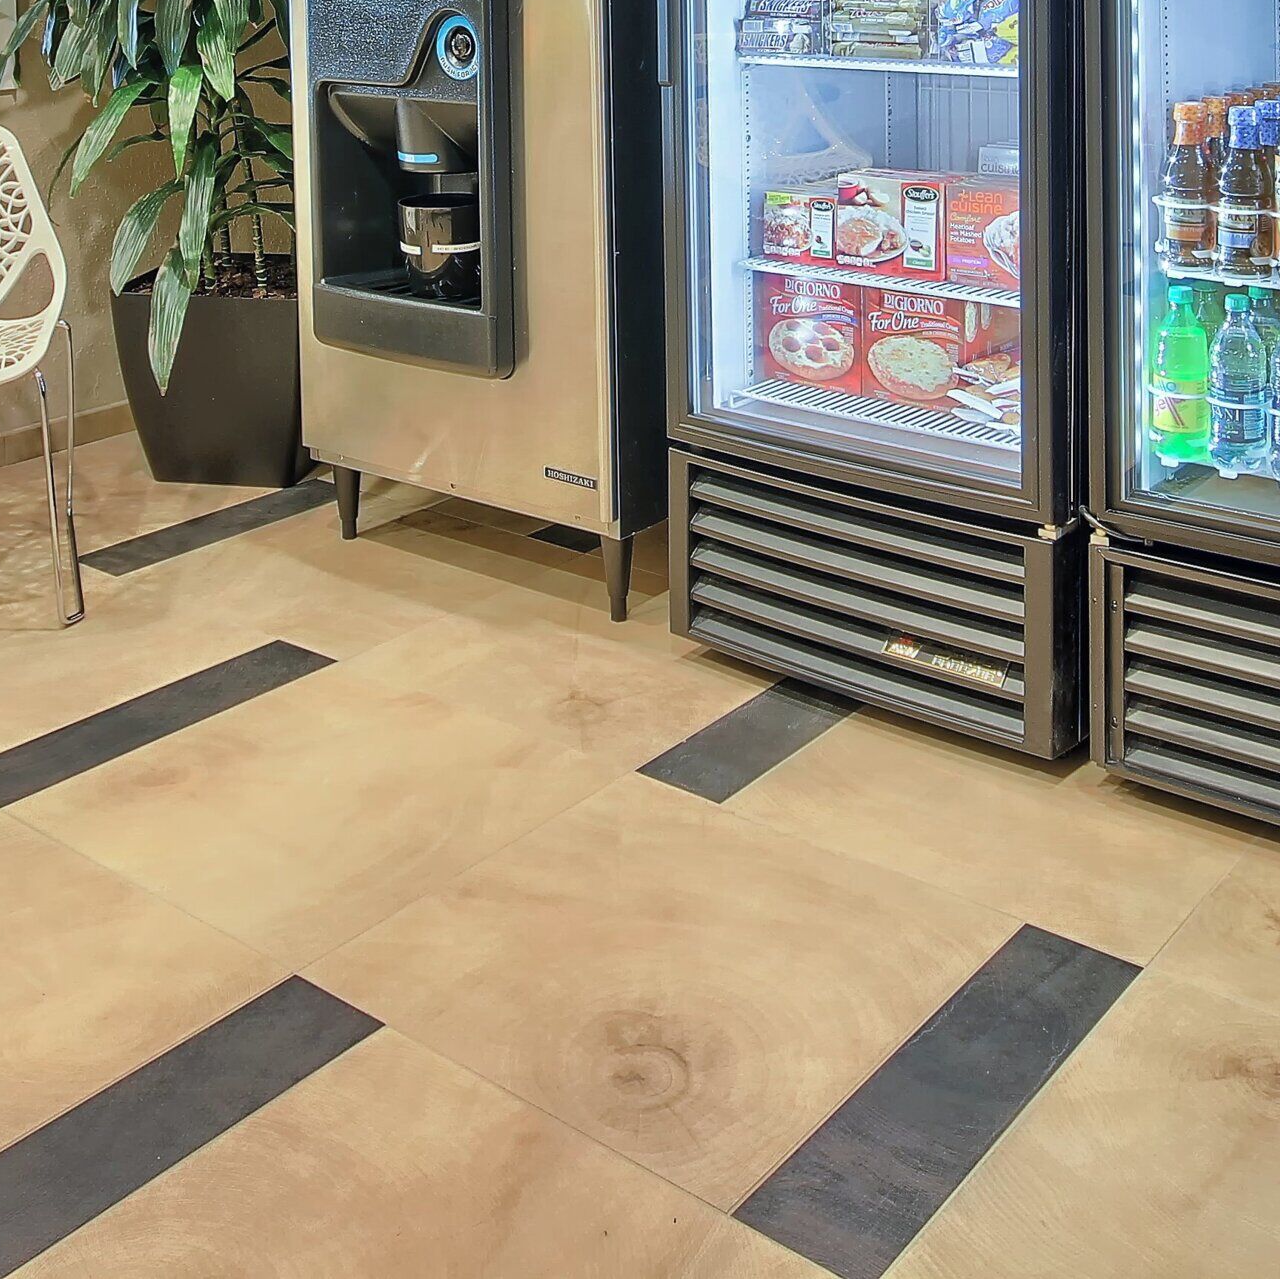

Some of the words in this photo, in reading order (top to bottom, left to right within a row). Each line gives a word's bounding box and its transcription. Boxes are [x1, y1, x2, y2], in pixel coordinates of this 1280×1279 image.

[743, 33, 788, 48] SNICKERS
[906, 188, 935, 201] Stouffer's
[969, 191, 1003, 205] Lean
[949, 236, 976, 244] Potatoes
[959, 230, 982, 238] Mashed
[769, 296, 792, 315] For
[791, 295, 817, 314] One
[868, 311, 891, 332] For
[891, 310, 919, 331] One
[548, 470, 594, 487] HOSHIZAKI
